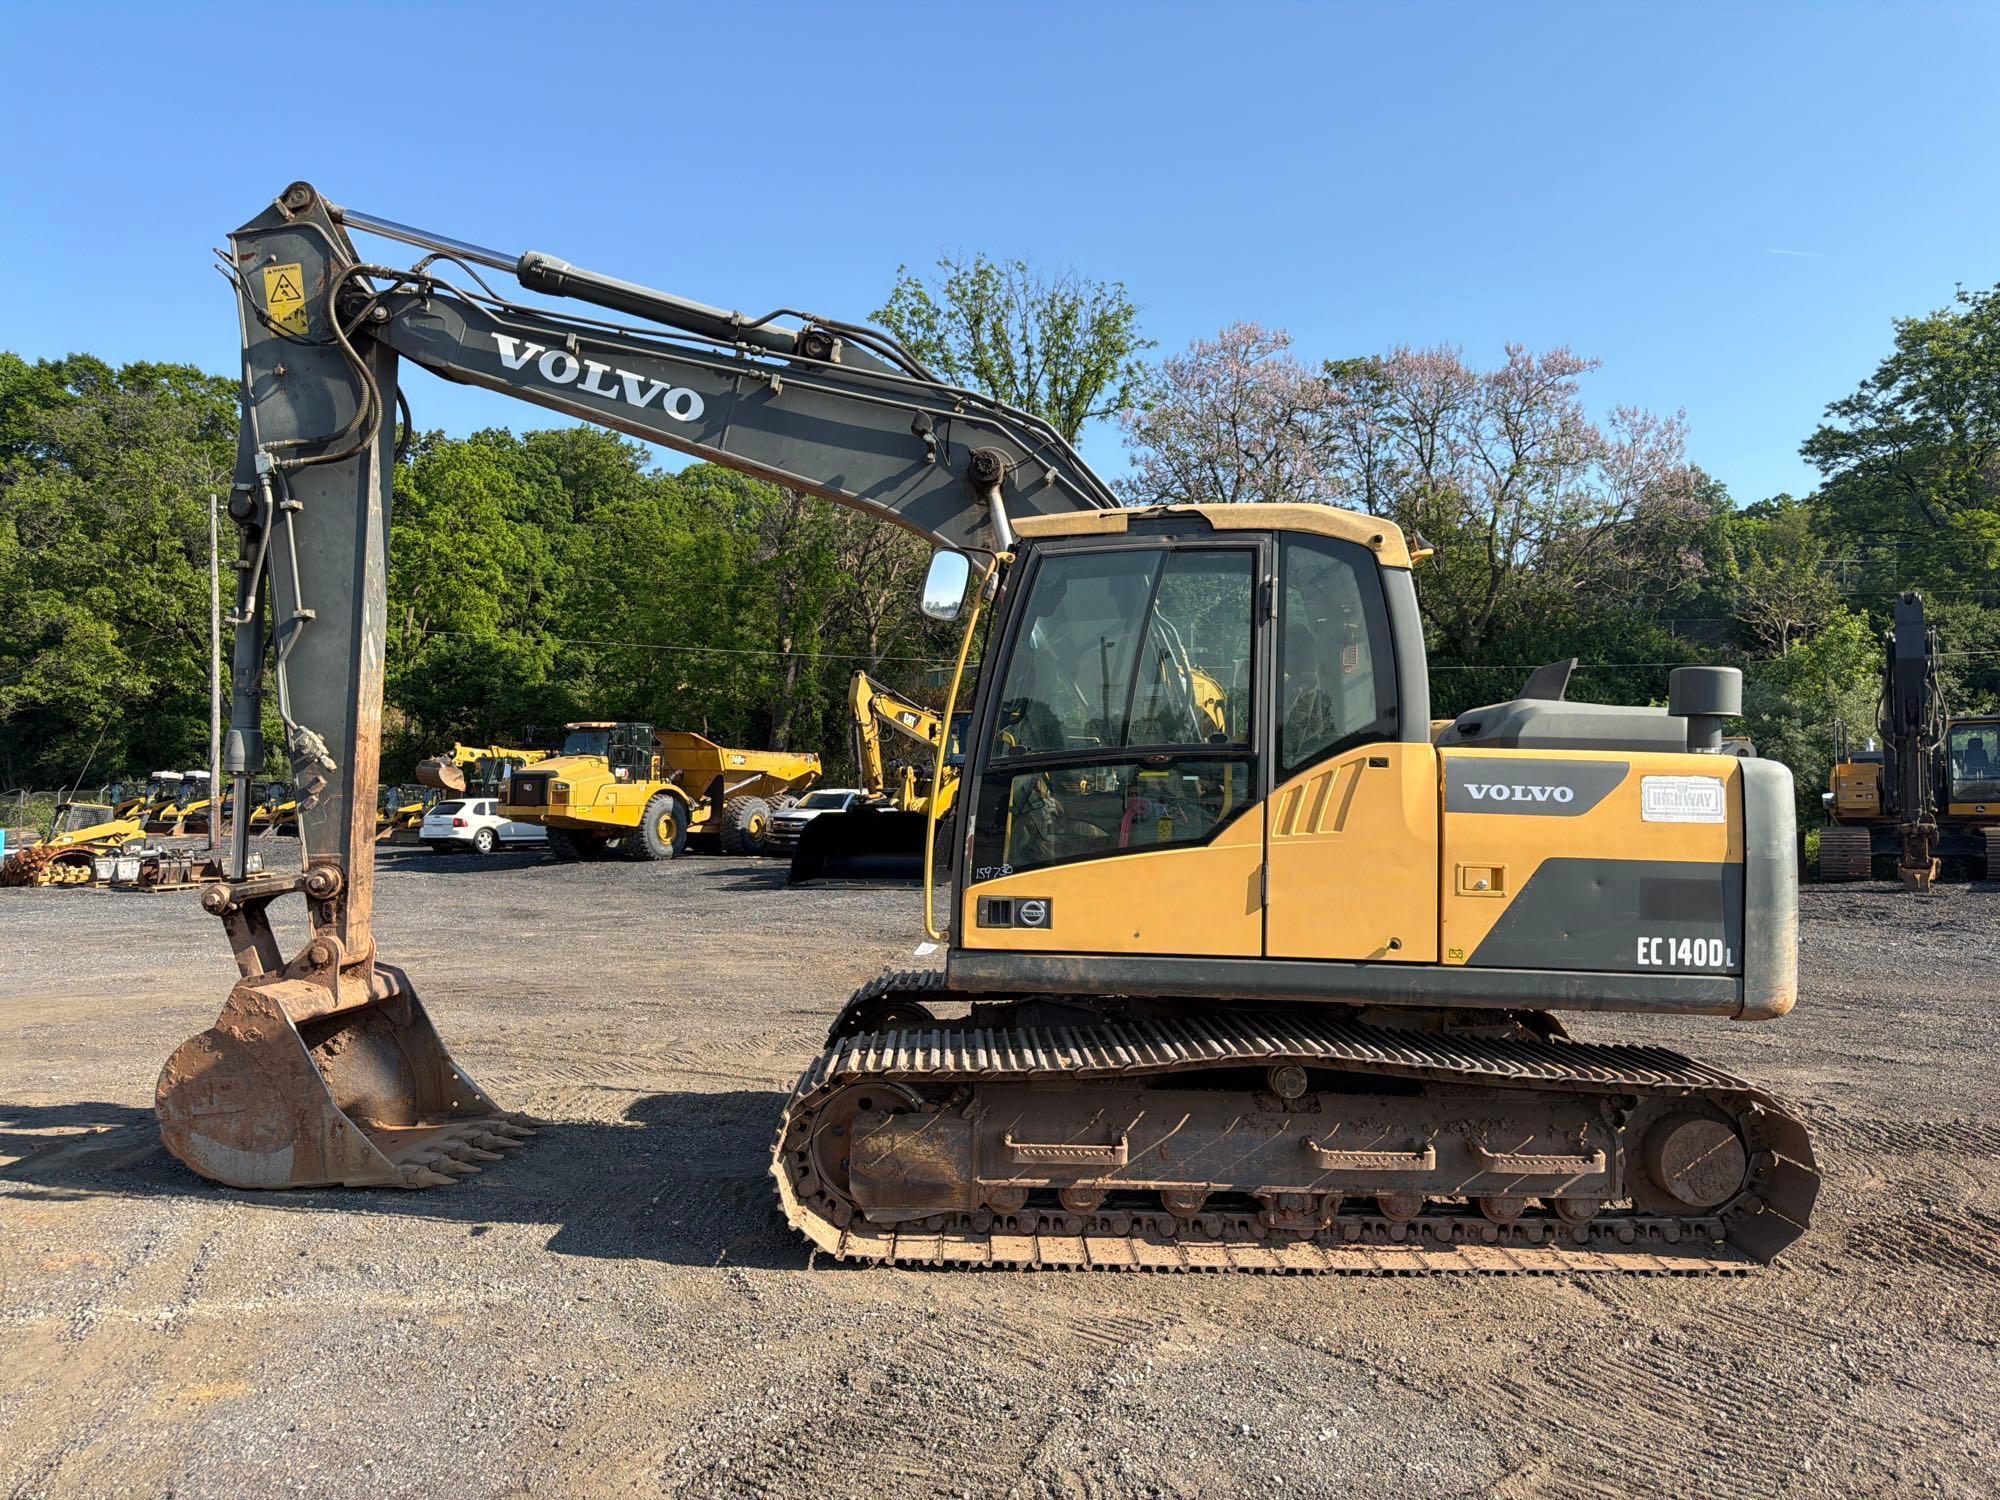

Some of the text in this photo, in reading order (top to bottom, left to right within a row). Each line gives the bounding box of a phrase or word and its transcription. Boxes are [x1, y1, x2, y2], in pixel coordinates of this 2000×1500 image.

[491, 332, 706, 422] VOLVO
[903, 712, 916, 728] CAT
[1463, 783, 1574, 803] VOLVO
[1652, 791, 1712, 807] HIGHWAY
